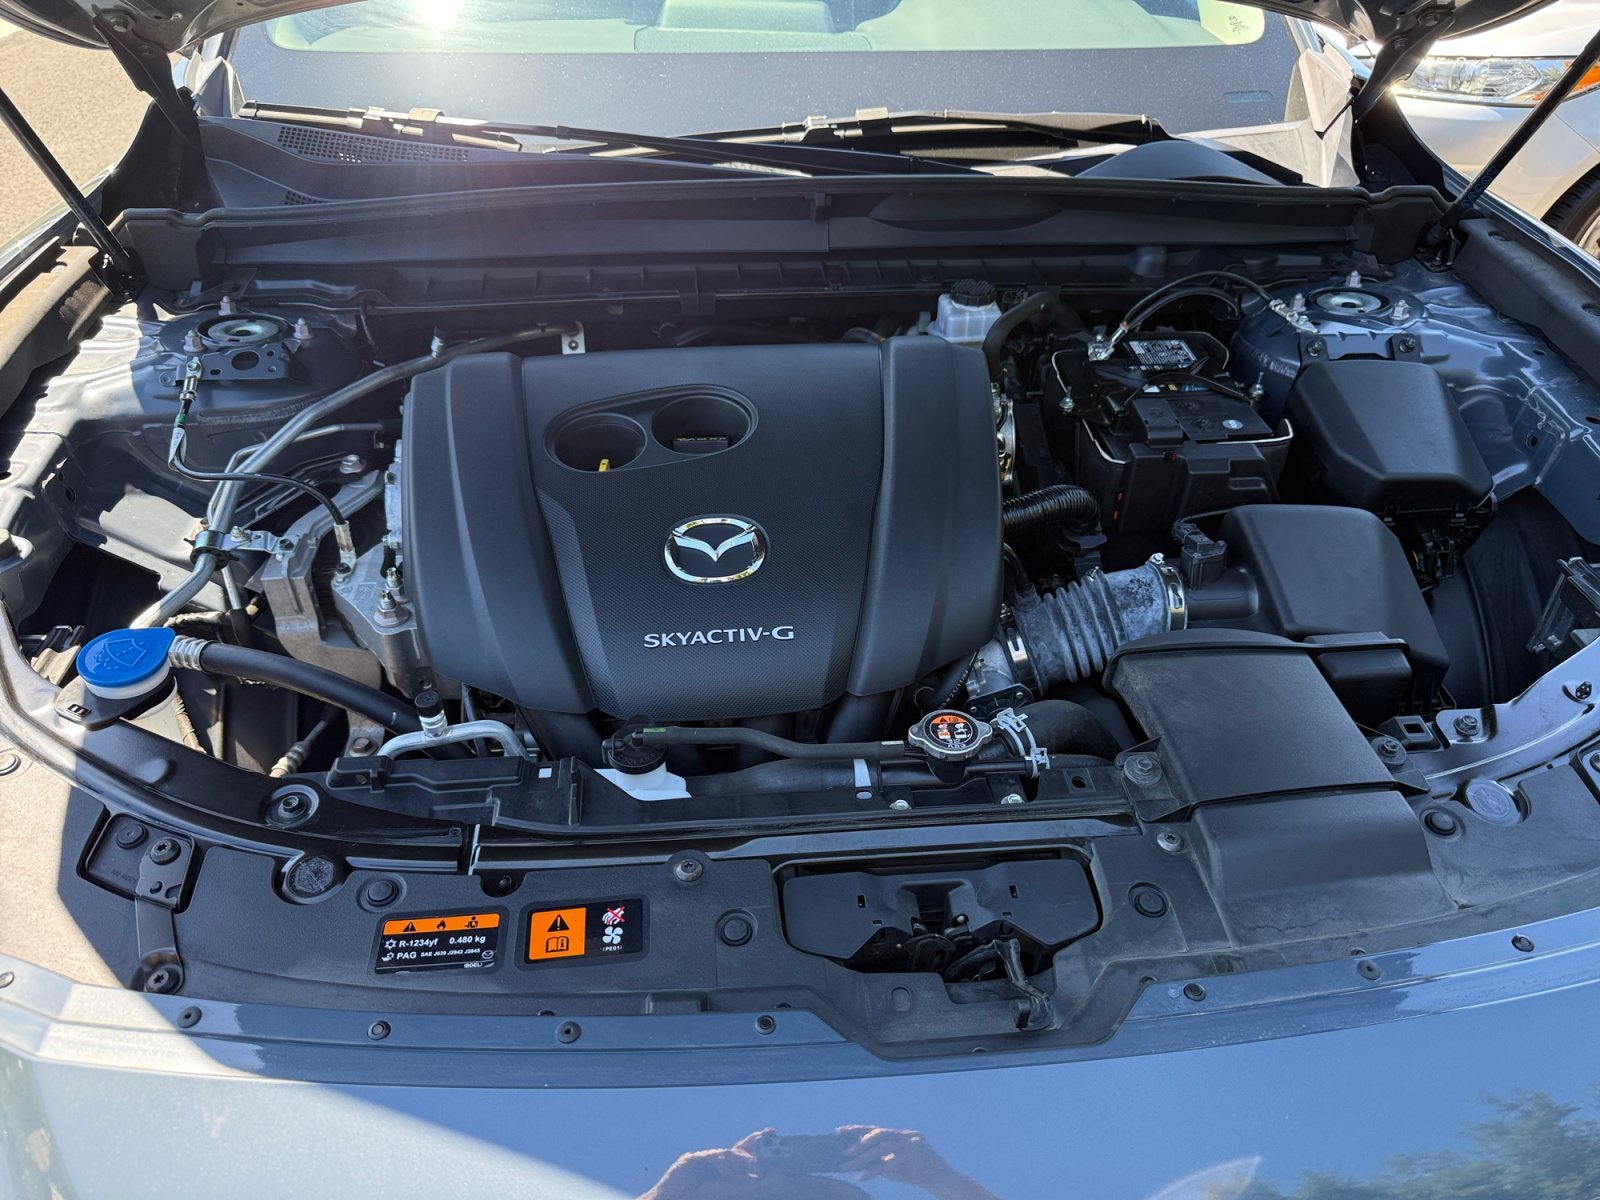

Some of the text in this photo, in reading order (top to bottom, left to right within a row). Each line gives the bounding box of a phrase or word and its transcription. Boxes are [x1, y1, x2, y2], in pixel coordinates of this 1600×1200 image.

[643, 625, 795, 648] SKYACTIV-G
[399, 935, 486, 948] R-1234yf 0.480 kg
[397, 951, 417, 960] PAG
